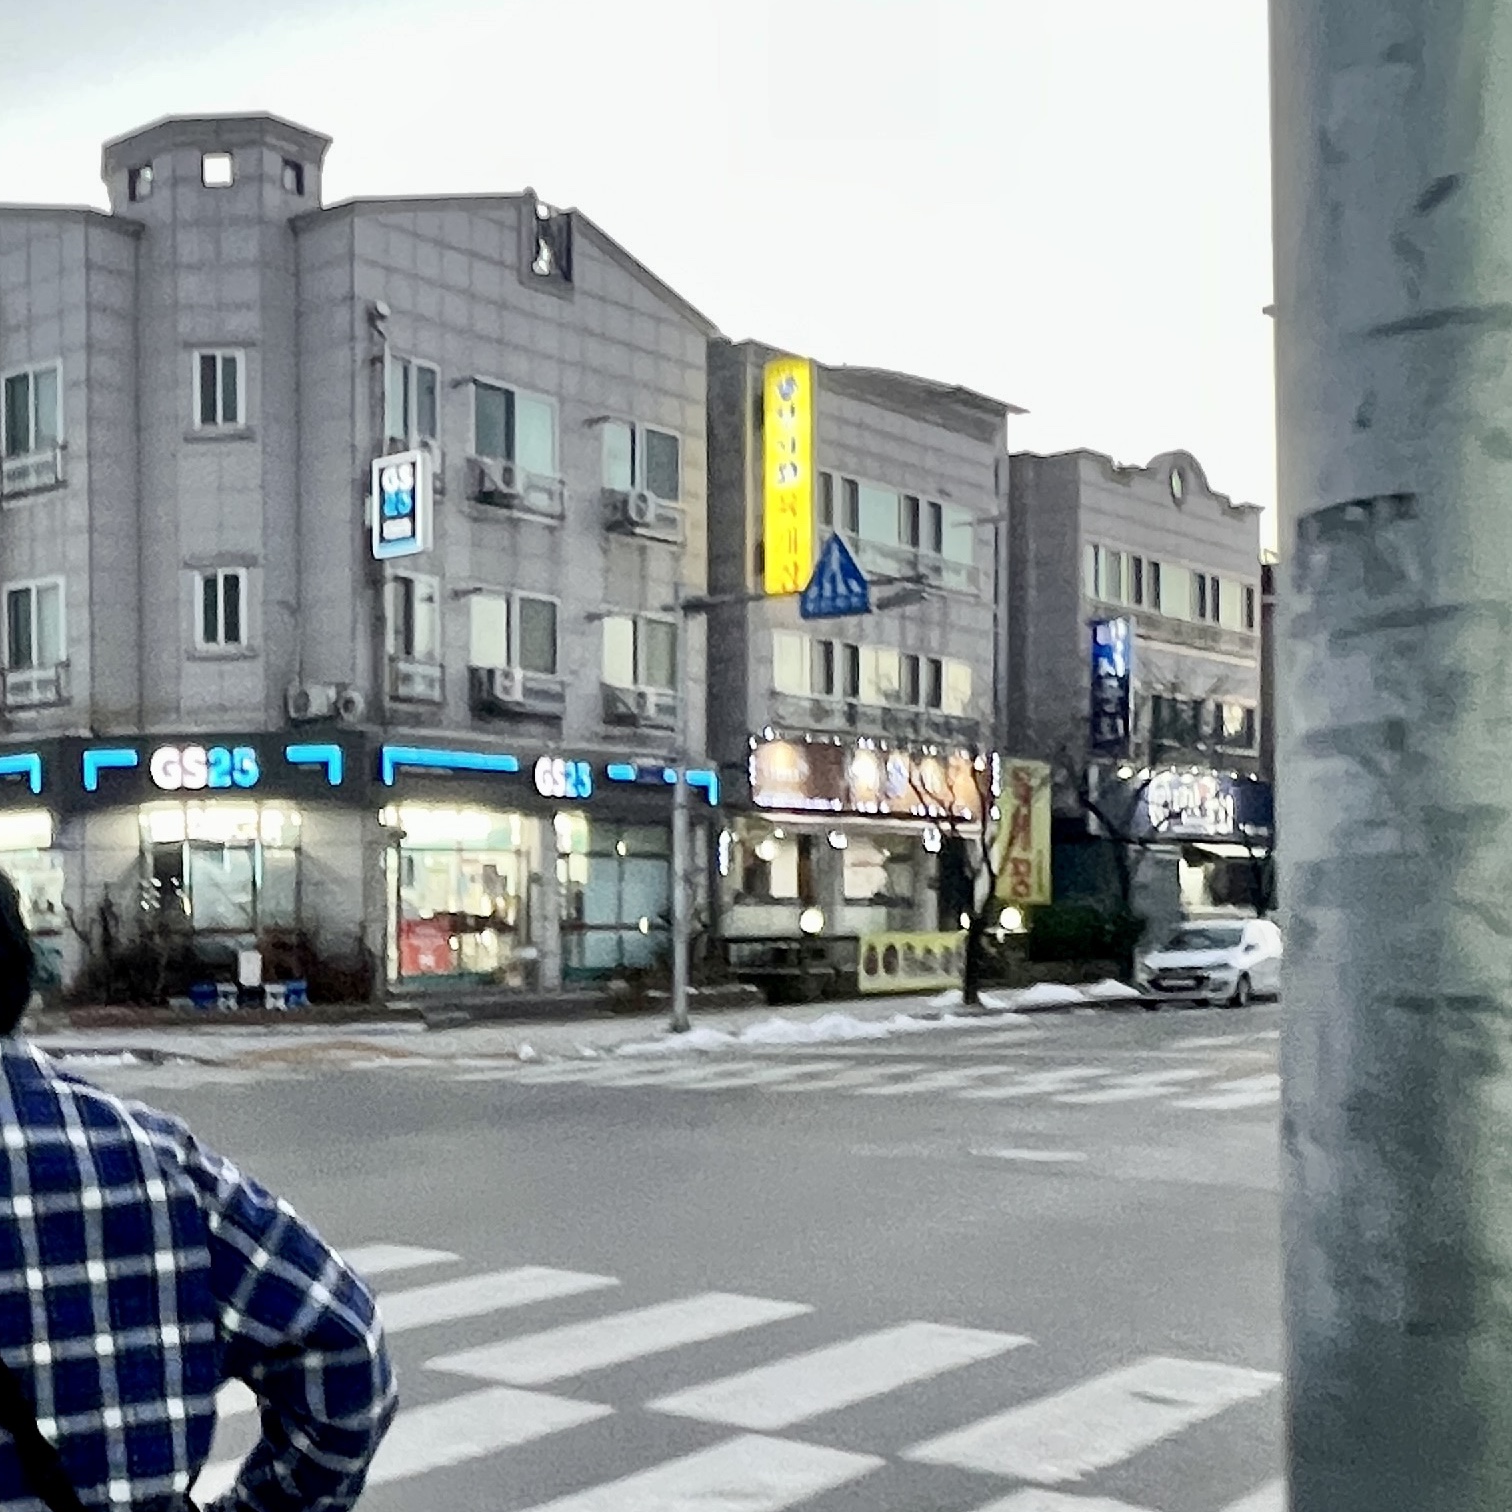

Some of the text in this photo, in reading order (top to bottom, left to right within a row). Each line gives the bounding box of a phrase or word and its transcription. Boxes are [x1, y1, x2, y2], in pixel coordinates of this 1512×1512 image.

[381, 463, 414, 492] GS
[150, 745, 260, 789] GS25
[534, 756, 592, 797] GS25
